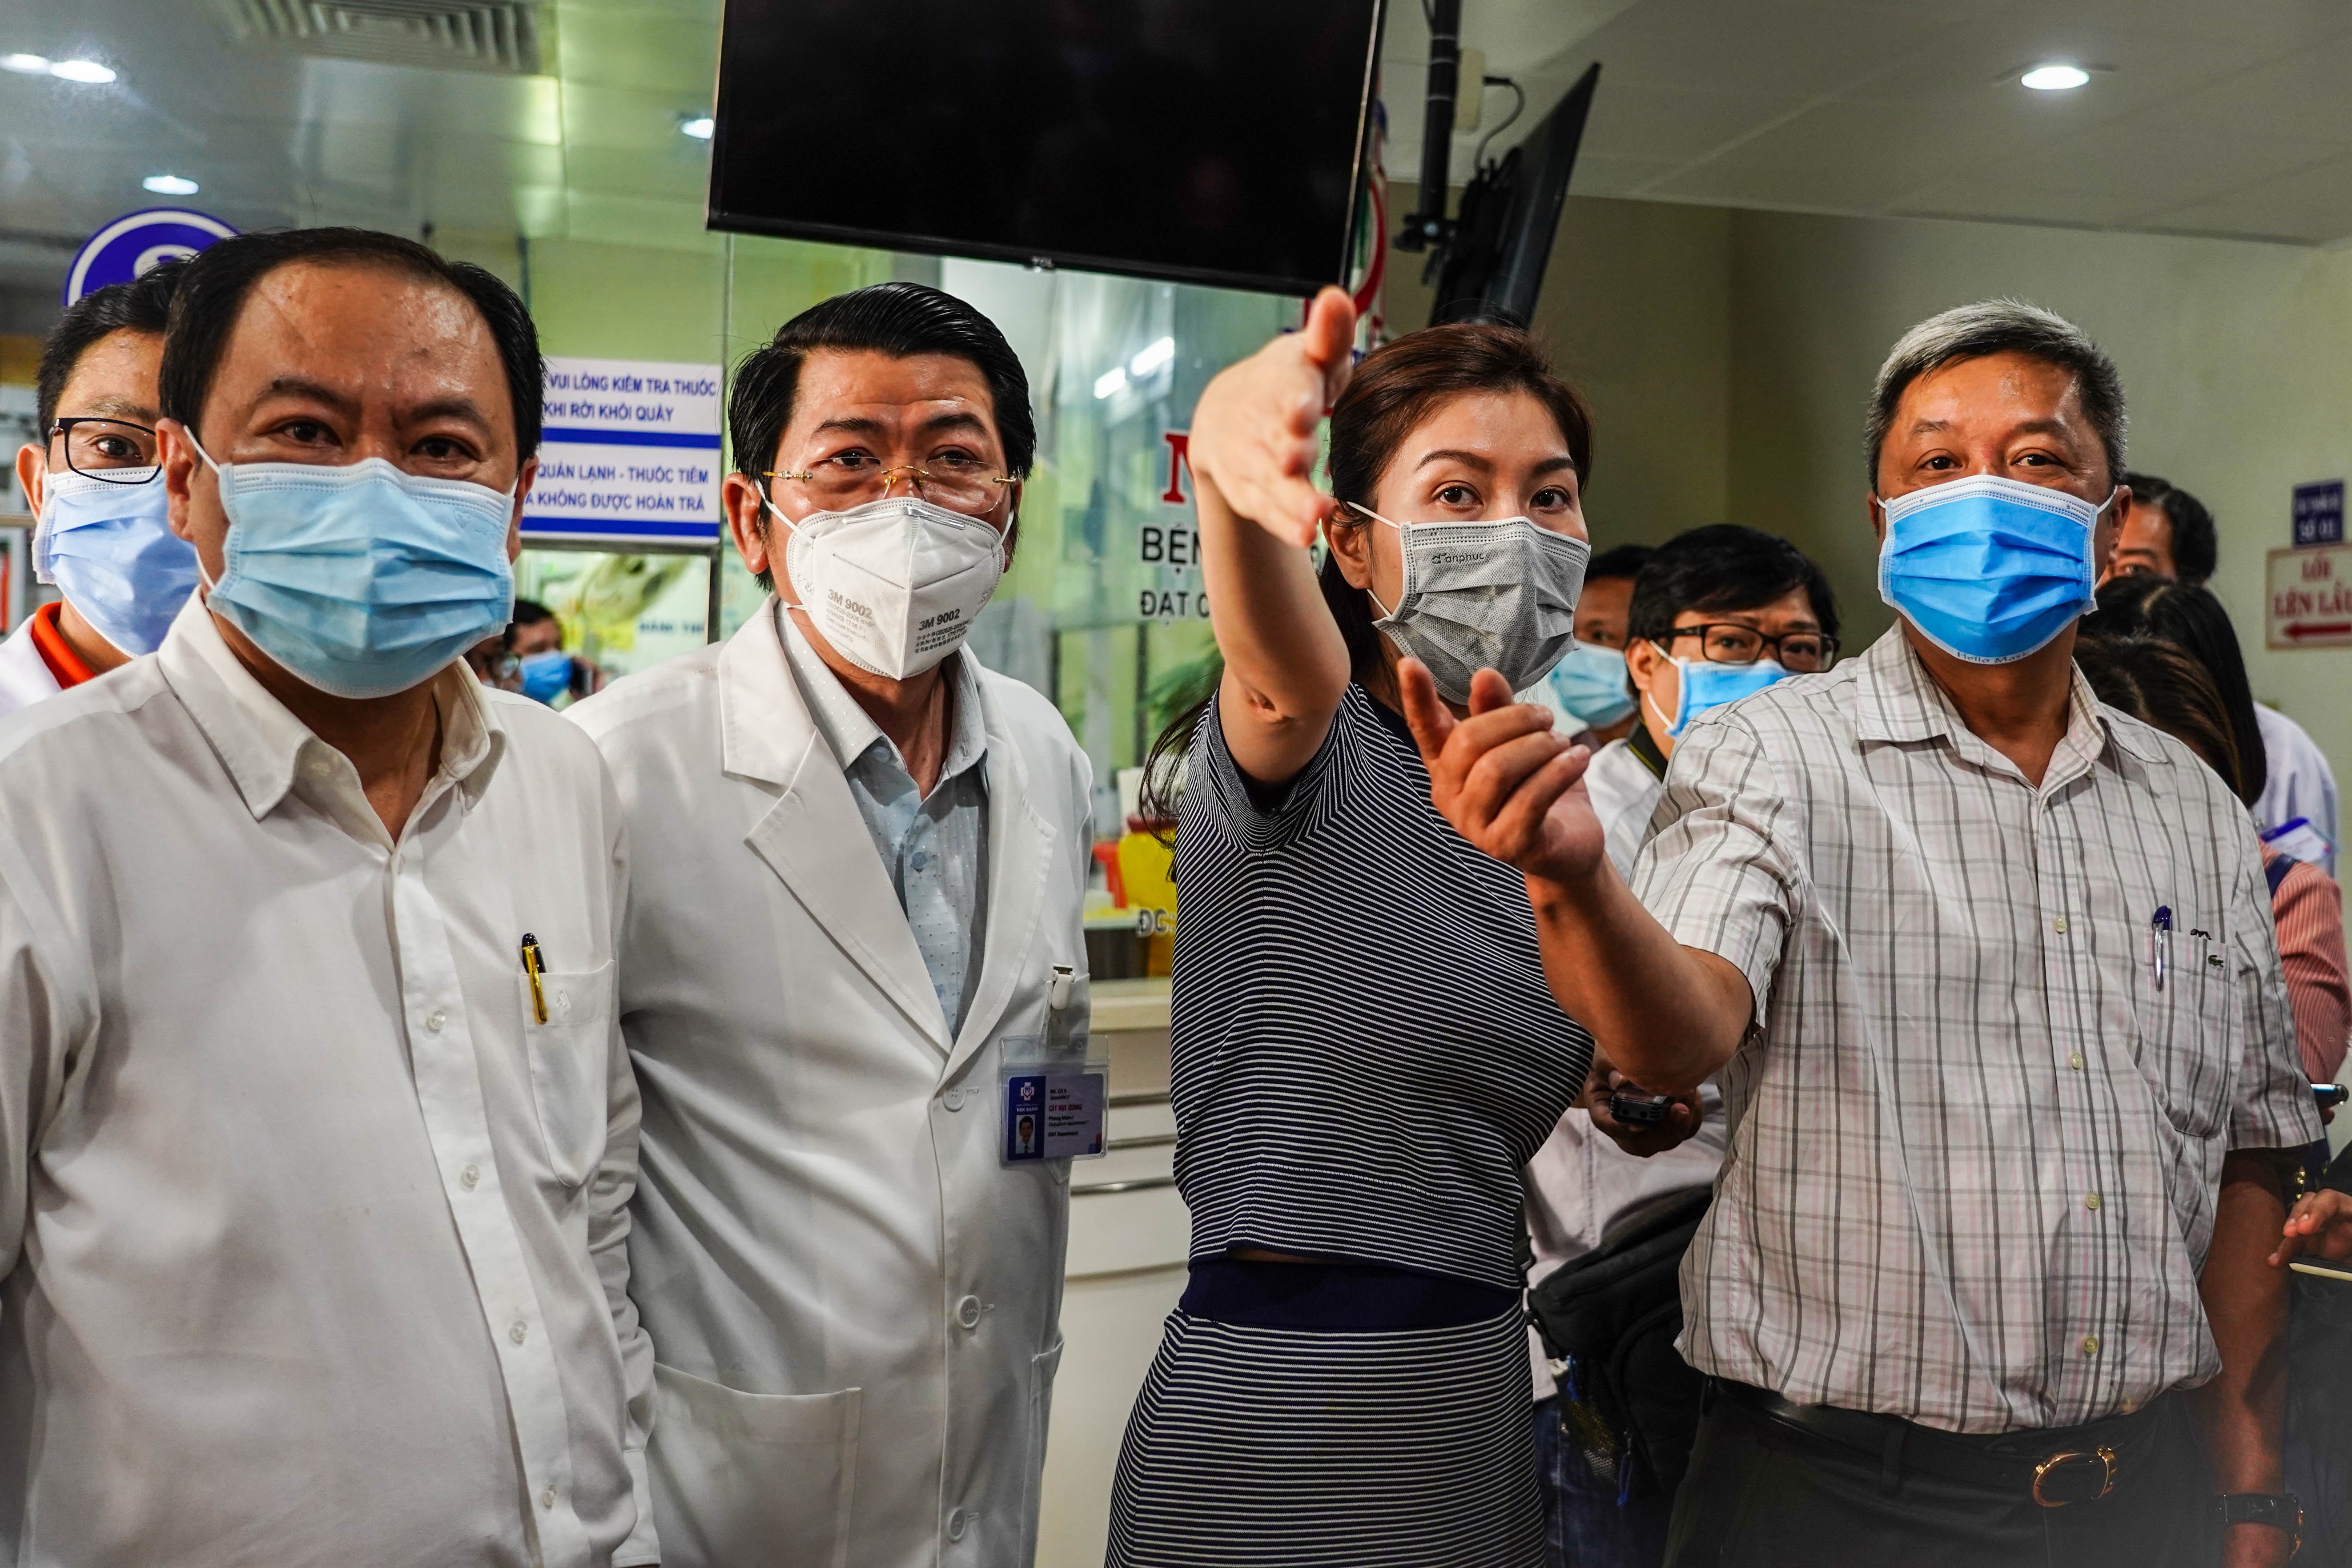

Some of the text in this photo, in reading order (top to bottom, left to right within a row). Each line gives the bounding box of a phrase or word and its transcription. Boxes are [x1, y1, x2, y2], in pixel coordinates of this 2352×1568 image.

[550, 374, 570, 389] VUI
[647, 378, 671, 394] TRA
[674, 378, 716, 396] THUỐC
[544, 402, 566, 417] KHI
[579, 464, 615, 483] LẠNH
[627, 465, 674, 483] THUỐC
[538, 489, 587, 508] KHÔNG
[591, 493, 632, 512] ĐƯỢC
[828, 588, 873, 619] 3M 9002
[1141, 590, 1190, 625] ĐẠT
[918, 617, 935, 631] 3M
[937, 608, 960, 625] 9002
